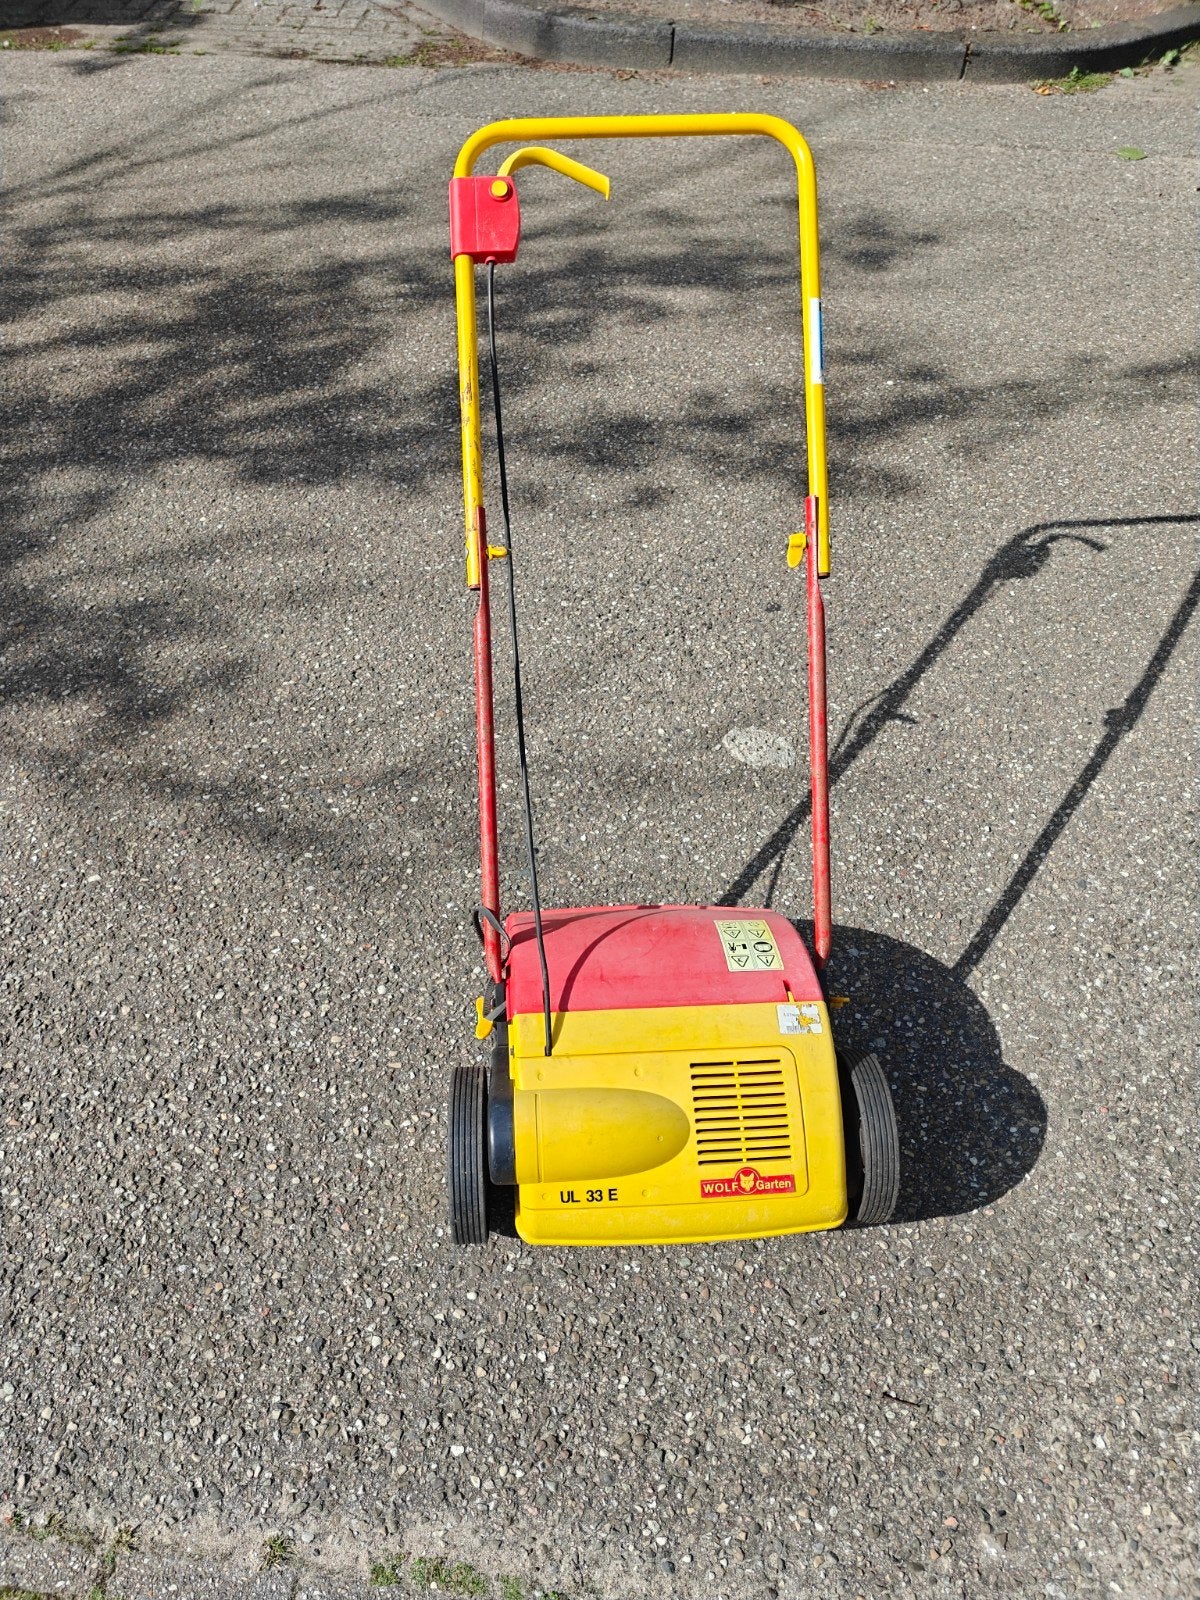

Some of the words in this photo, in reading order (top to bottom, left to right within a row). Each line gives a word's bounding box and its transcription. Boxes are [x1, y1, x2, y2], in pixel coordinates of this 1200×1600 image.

[703, 1182, 739, 1194] WOLF
[757, 1180, 792, 1190] Garten
[560, 1190, 581, 1203] UL
[586, 1189, 603, 1202] 33
[608, 1188, 618, 1201] E
